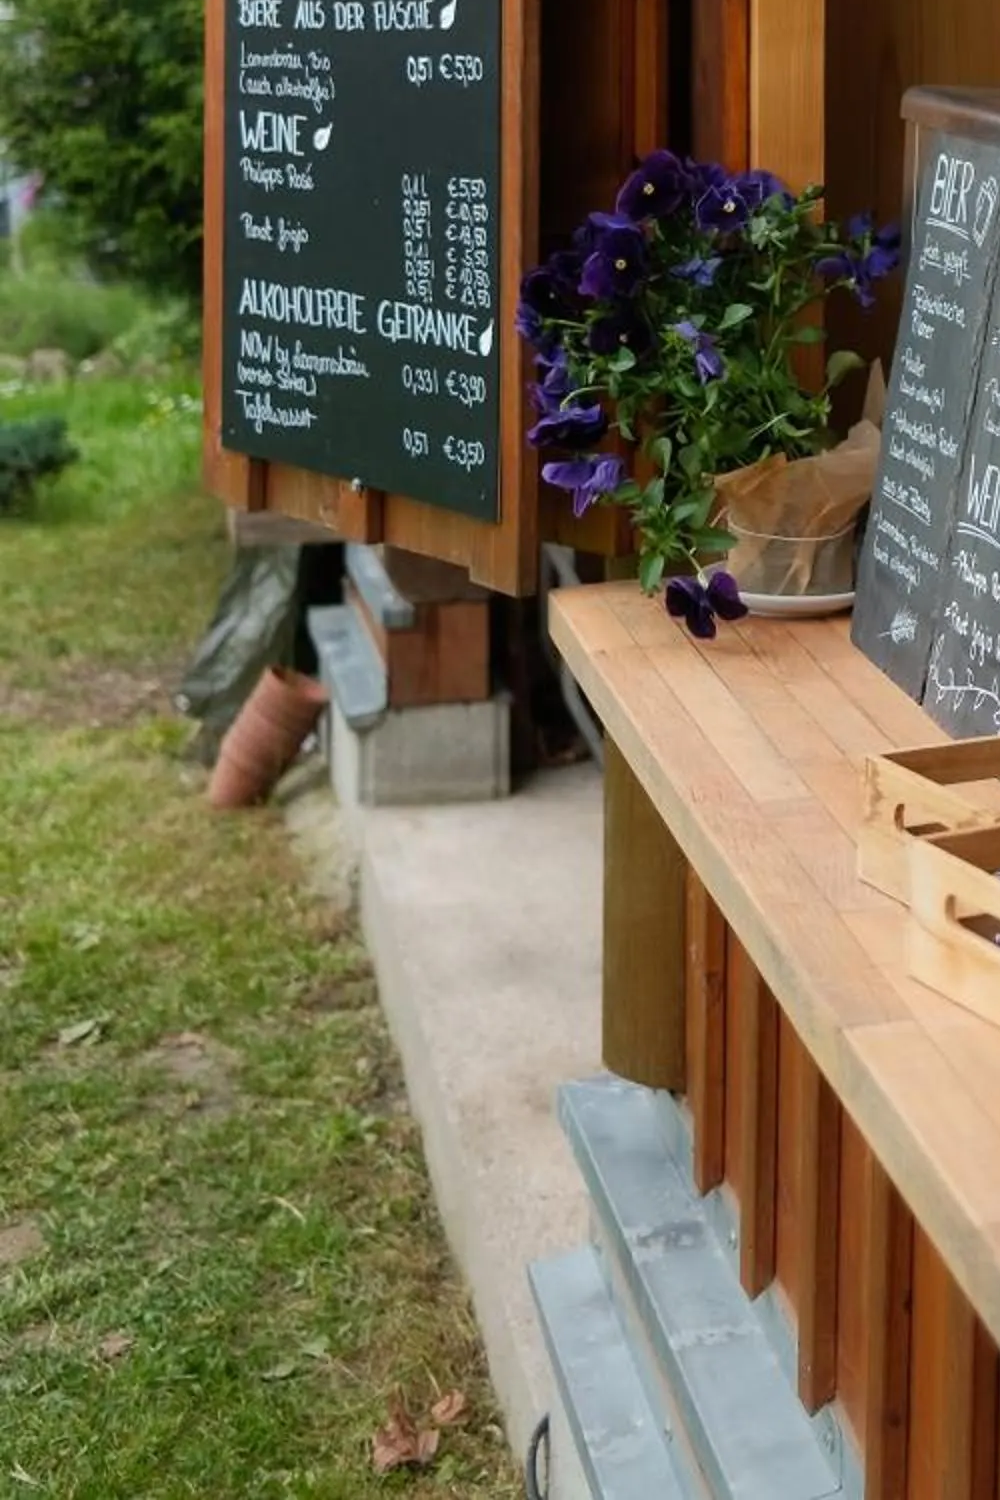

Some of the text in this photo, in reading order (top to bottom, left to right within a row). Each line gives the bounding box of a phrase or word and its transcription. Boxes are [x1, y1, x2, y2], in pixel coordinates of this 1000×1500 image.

[334, 1, 365, 31] DER
[239, 110, 307, 157] WEINE
[285, 162, 315, 191] Rosé
[930, 153, 975, 223] BIER
[239, 278, 367, 333] ALKOHOLFREIE
[240, 328, 272, 363] NOW
[275, 335, 291, 374] by
